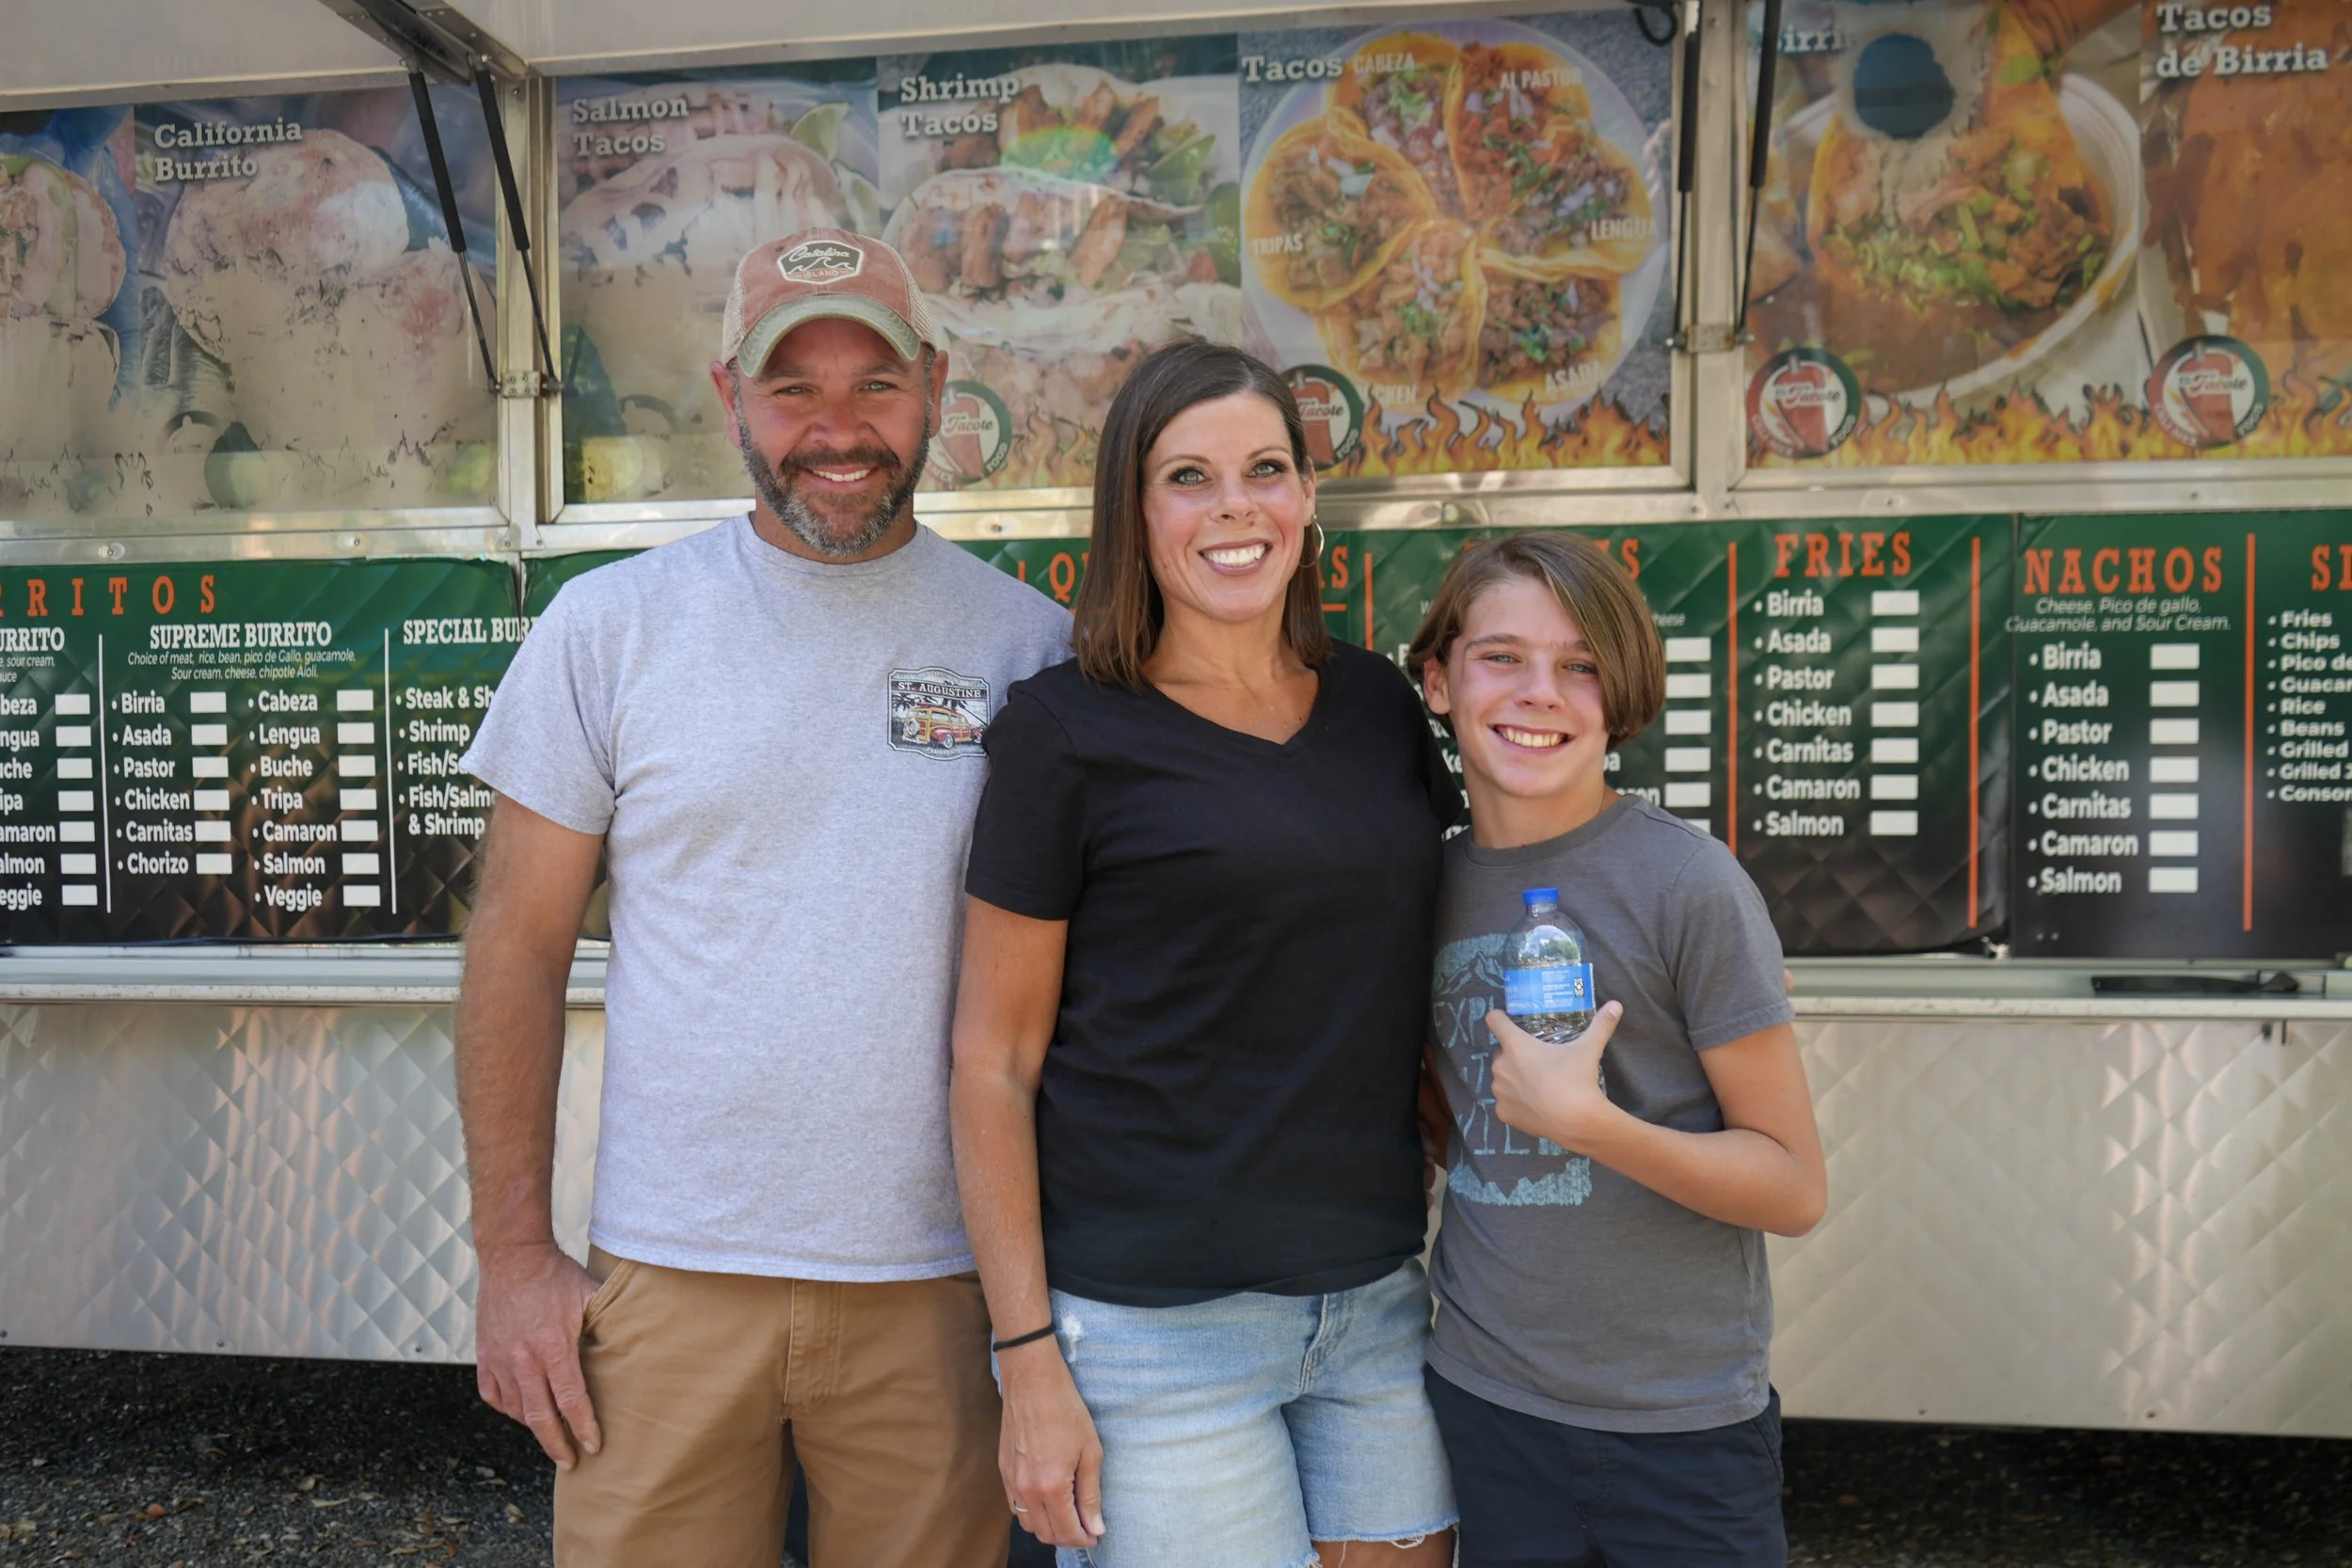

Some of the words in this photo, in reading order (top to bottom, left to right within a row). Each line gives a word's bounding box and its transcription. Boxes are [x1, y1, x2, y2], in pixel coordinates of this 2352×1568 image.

[2156, 4, 2272, 32] Tacos
[1241, 55, 1343, 82] Tacos
[1353, 53, 1416, 75] CABEZA
[2156, 48, 2203, 78] de
[2214, 40, 2328, 74] Birria
[900, 73, 1020, 105] Shrimp
[1500, 71, 1517, 89] AL
[572, 93, 689, 124] Salmon
[154, 118, 301, 150] California
[901, 109, 998, 138] Tacos
[574, 131, 665, 158] Tacos
[154, 156, 257, 182] Burrito
[789, 245, 850, 262] Catalina
[1251, 232, 1303, 257] TRIPAS
[803, 269, 839, 279] ISLAND
[944, 415, 993, 435] Tacote
[985, 442, 1009, 472] FOOD
[1773, 531, 1912, 578] FRIES
[2024, 546, 2223, 594] NACHOS
[0, 574, 215, 617] RITOS
[1767, 589, 1823, 617] Birria
[2036, 597, 2095, 614] Cheese,
[2099, 597, 2133, 613] Pico
[2137, 595, 2156, 612] de
[2159, 595, 2201, 616] gallo,
[403, 618, 486, 644] SPECIAL
[2005, 615, 2097, 633] Guacamole,
[2102, 615, 2132, 631] and
[2136, 615, 2172, 631] Sour
[2175, 614, 2231, 631] Cream.
[2280, 608, 2332, 628] Fries
[150, 624, 240, 649] SUPREME
[244, 621, 332, 648] BURRITO
[1767, 626, 1831, 653] Asada
[2280, 630, 2341, 652] Chips
[7, 657, 24, 668] sour
[26, 656, 56, 669] cream,
[128, 651, 158, 666] Choice
[159, 650, 169, 664] of
[170, 652, 194, 665] meat,
[199, 651, 216, 665] rice,
[218, 649, 242, 664] bean,
[244, 649, 263, 666] pico
[265, 648, 277, 662] de
[278, 648, 302, 664] Gallo,
[304, 646, 355, 666] guacamole,
[2042, 641, 2102, 670] Birria
[2280, 652, 2327, 672] Pico
[171, 666, 192, 680] Sour
[193, 668, 222, 681] cream,
[224, 666, 257, 680] cheese,
[259, 665, 295, 681] chipotle
[1767, 664, 1835, 689] Pastor
[122, 689, 165, 714] Birria
[258, 689, 319, 713] Cabeza
[405, 686, 453, 709] Steak
[457, 686, 469, 709] &
[898, 682, 915, 691] ST.
[919, 683, 981, 699] AUGUSTINE
[2042, 680, 2108, 707] Asada
[1767, 700, 1852, 726] Chicken
[2280, 695, 2326, 715] Rice
[122, 723, 172, 747] Asada
[260, 722, 321, 749] Lengua
[409, 718, 470, 747] Shrimp
[2042, 719, 2112, 744] Pastor
[2280, 720, 2345, 736] Beans
[1767, 736, 1853, 764] Carnitas
[2280, 739, 2348, 758] Grilled
[123, 757, 176, 779] Pastor
[261, 754, 313, 777] Buche
[407, 750, 465, 777] Fish/S
[2042, 755, 2129, 782] Chicken
[2279, 761, 2341, 780] Grilled
[124, 788, 190, 811] Chicken
[1767, 774, 1860, 800] Camaron
[261, 787, 304, 814] Tripa
[2042, 791, 2132, 819] Carnitas
[126, 820, 193, 843] Carnitas
[262, 820, 338, 843] Camaron
[408, 813, 421, 836] &
[424, 811, 485, 840] Shrimp
[1766, 810, 1844, 836] Salmon
[2042, 830, 2138, 856] Camaron
[127, 852, 189, 875] Chorizo
[263, 852, 326, 875] Salmon
[2041, 866, 2122, 894] Salmon
[265, 883, 323, 912] Veggie
